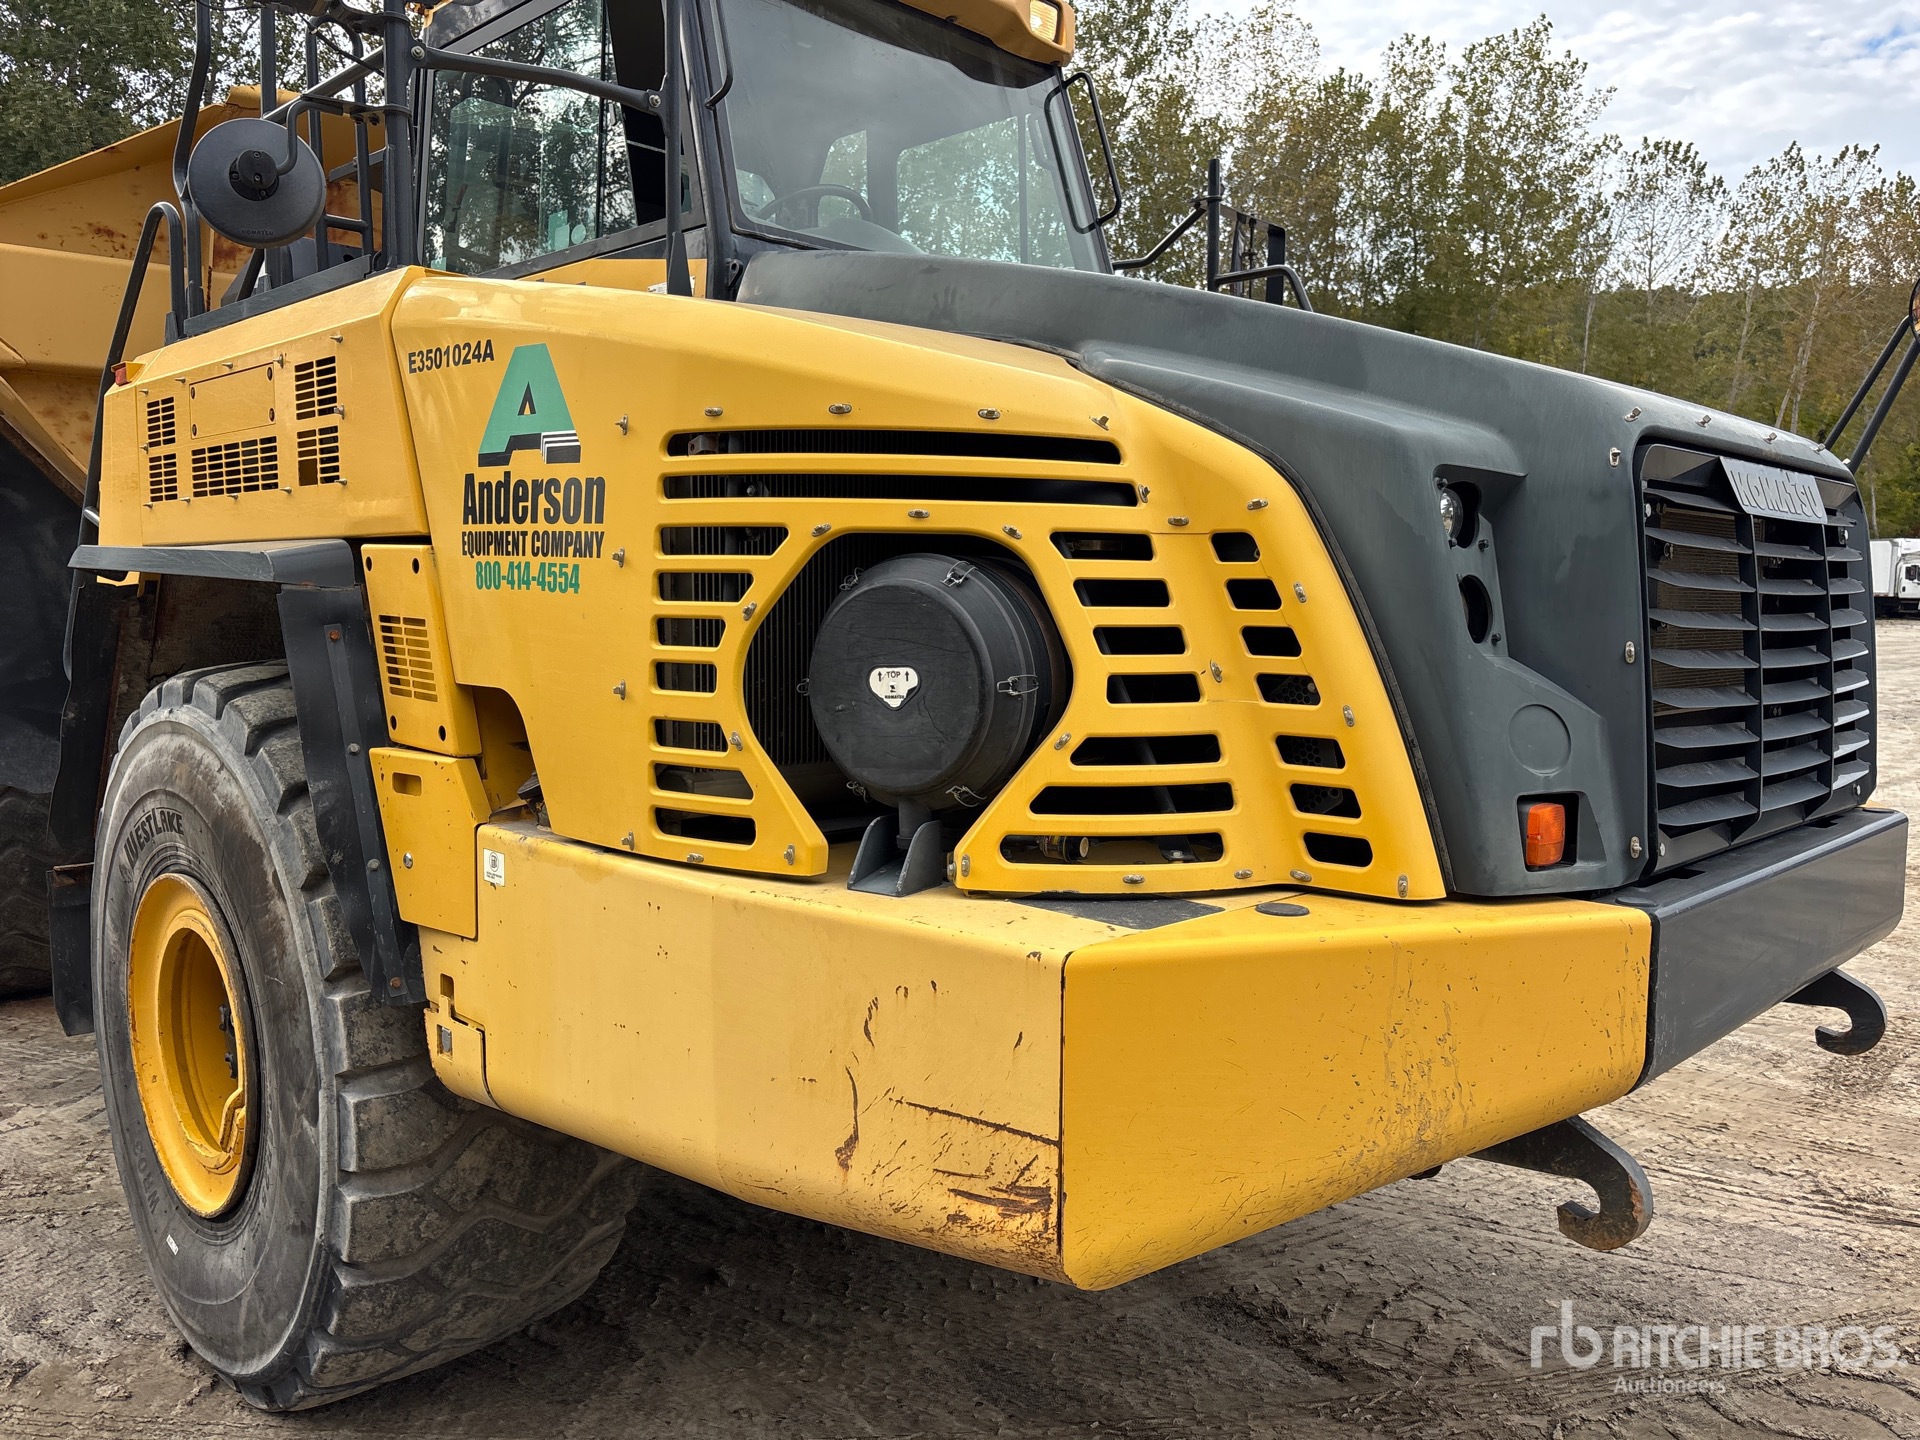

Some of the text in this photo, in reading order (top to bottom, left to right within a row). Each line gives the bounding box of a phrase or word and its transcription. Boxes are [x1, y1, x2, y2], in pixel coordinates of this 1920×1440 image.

[407, 339, 495, 374] E3501024A
[462, 471, 606, 525] Anderson
[1729, 470, 1823, 519] KOMATSU
[461, 530, 605, 558] EQUIPMENT COMPANY
[475, 560, 580, 594] 800-414-4554
[886, 671, 901, 679] TOP
[123, 807, 184, 870] WESTLAKE
